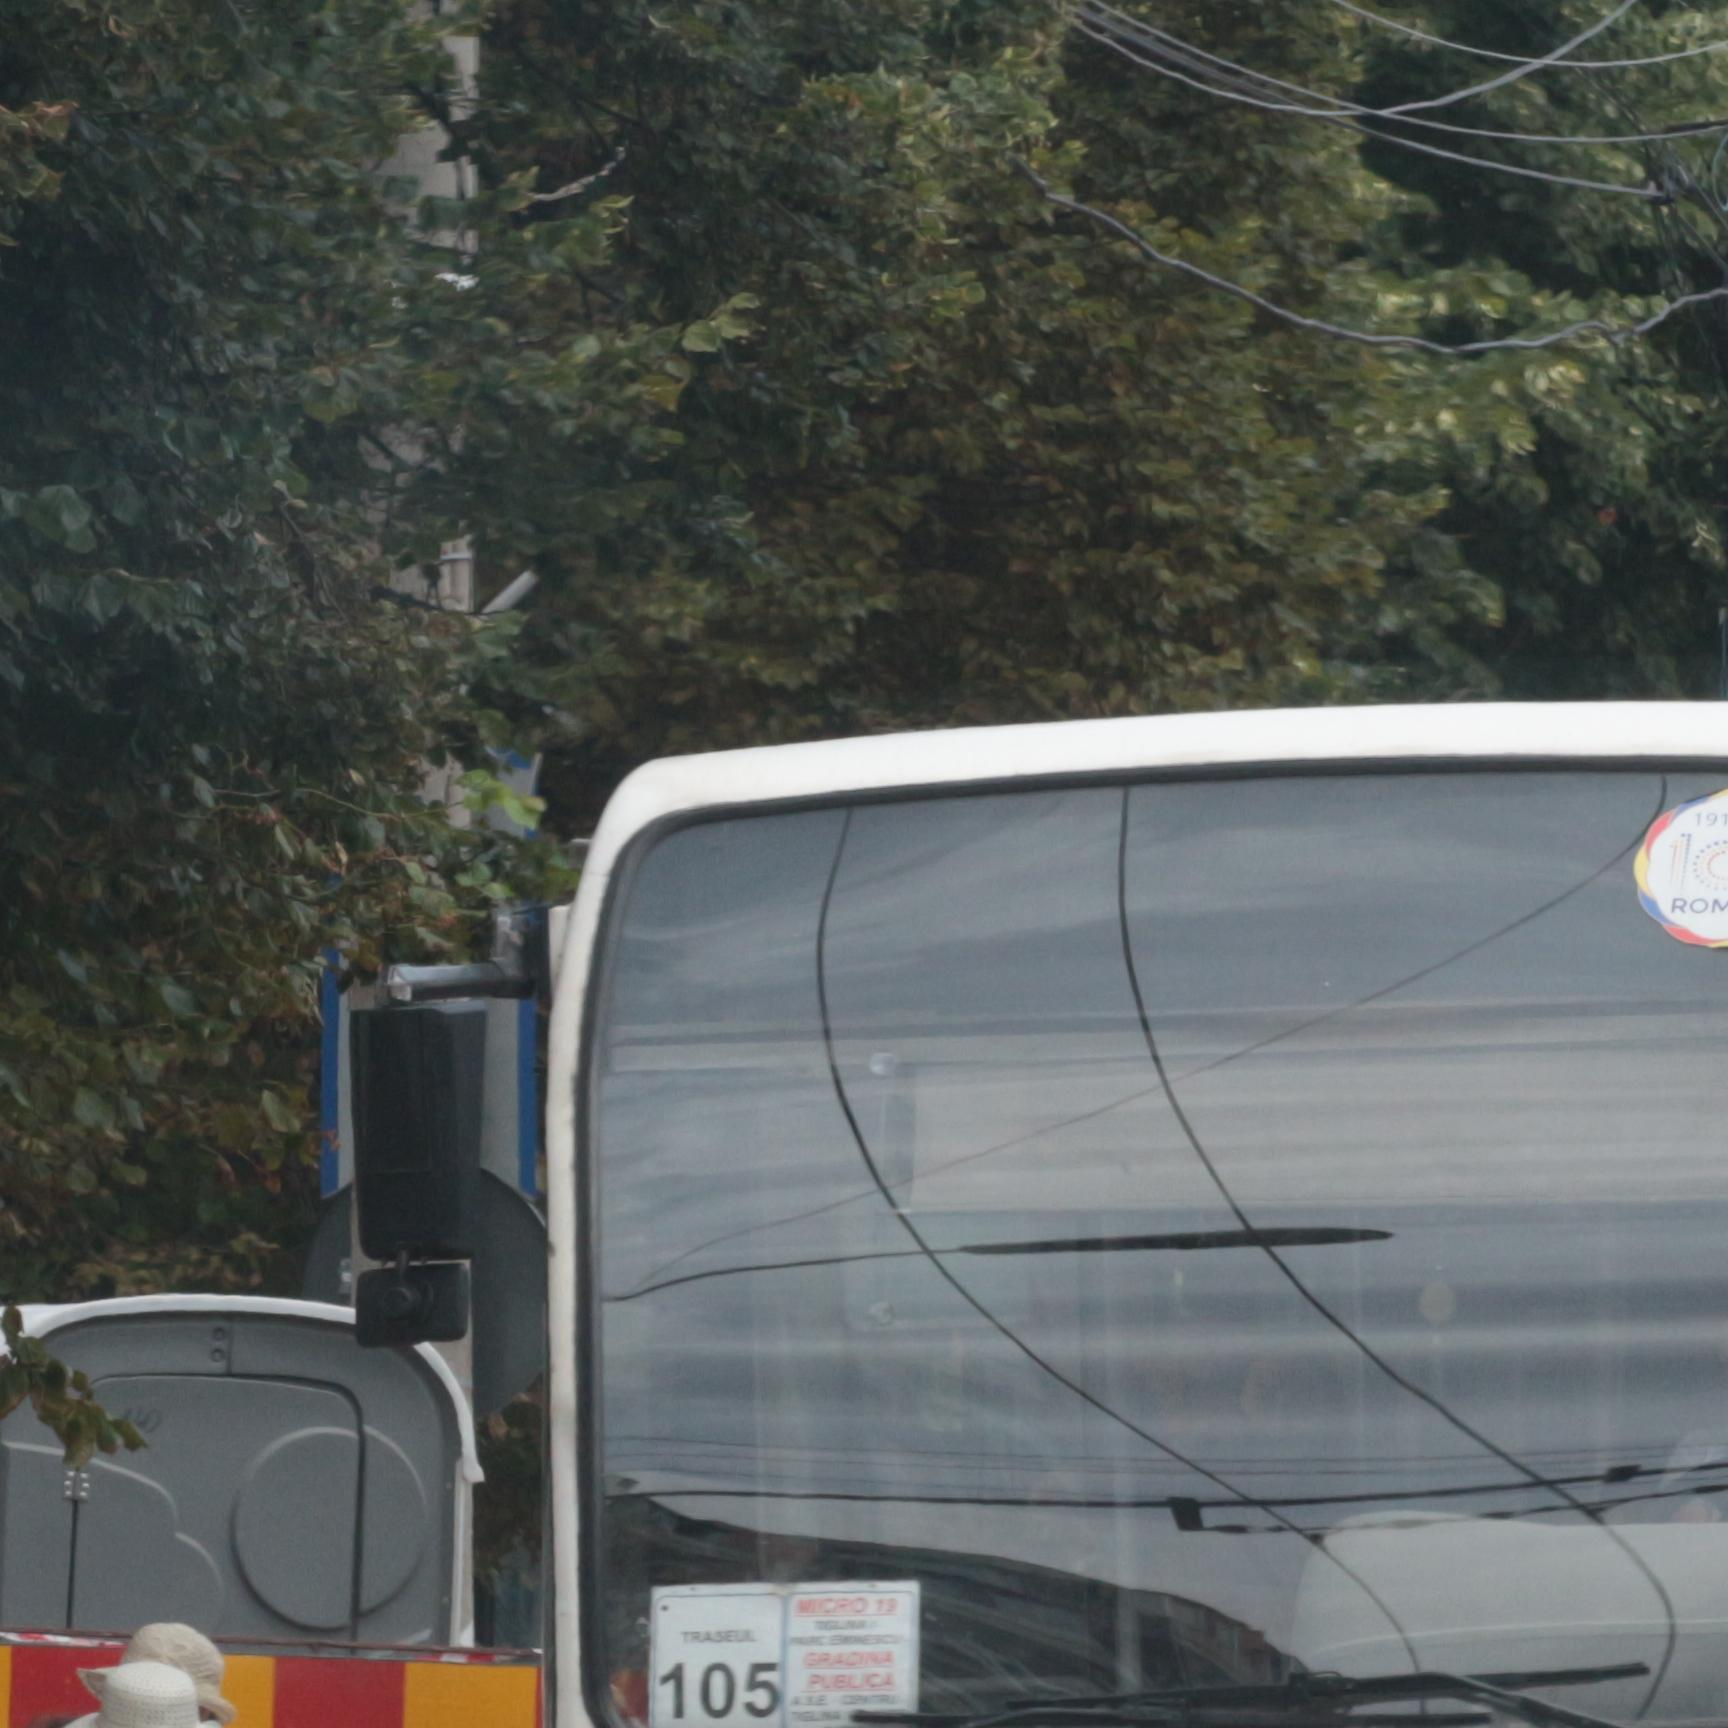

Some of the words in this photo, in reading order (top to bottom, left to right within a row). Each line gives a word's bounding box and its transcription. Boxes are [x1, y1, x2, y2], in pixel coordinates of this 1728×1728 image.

[795, 1597, 869, 1615] MICRO
[680, 1629, 757, 1644] TRASEUL
[802, 1651, 895, 1667] GRADINA
[808, 1672, 895, 1690] PUBLICA
[658, 1662, 780, 1721] 105
